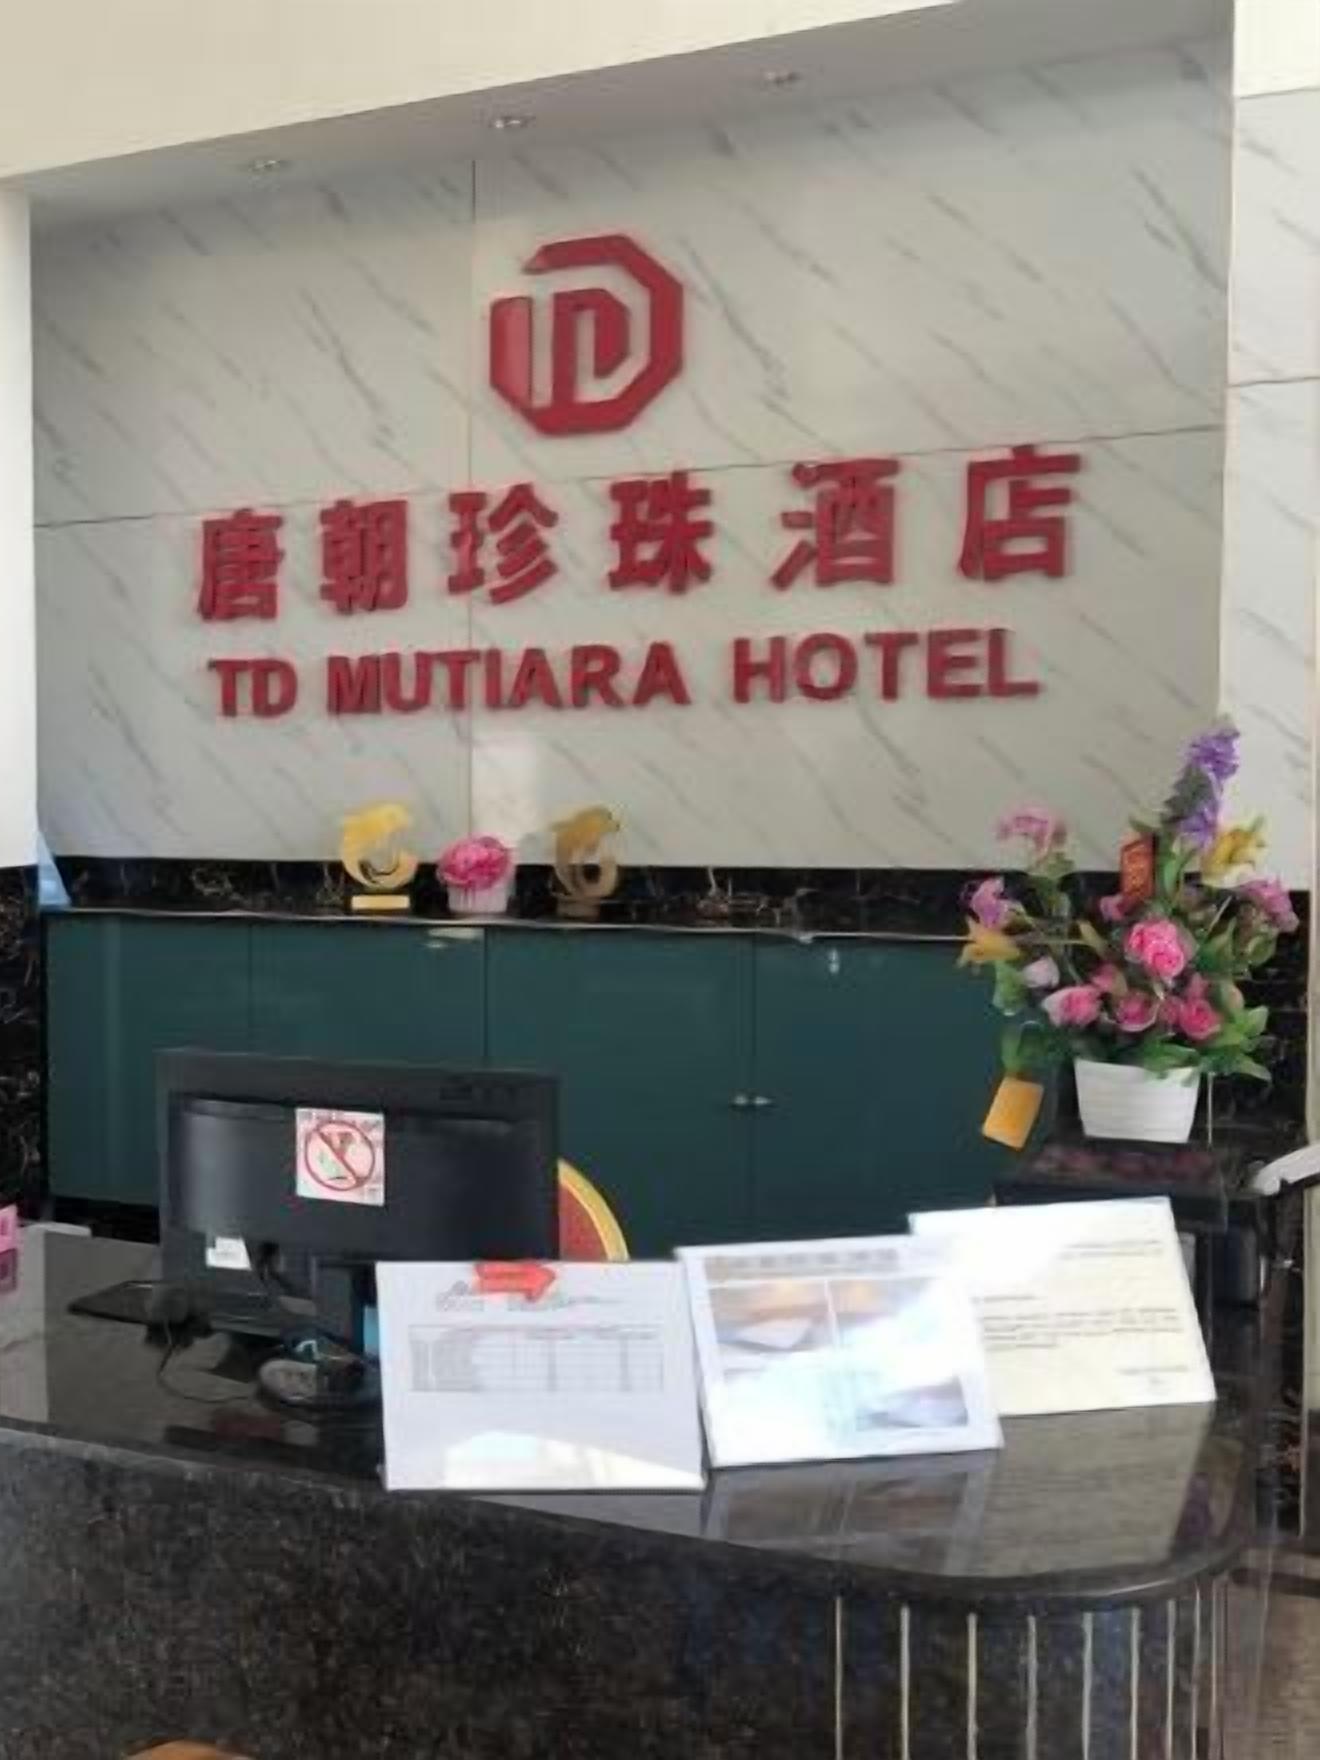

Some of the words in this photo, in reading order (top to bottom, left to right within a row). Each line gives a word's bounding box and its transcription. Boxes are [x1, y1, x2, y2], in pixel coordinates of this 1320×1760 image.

[197, 444, 1082, 621] 唐朝珍珠酒店
[209, 656, 298, 717] TD
[326, 641, 691, 714] MUTIARA
[732, 628, 1041, 702] HOTEL
